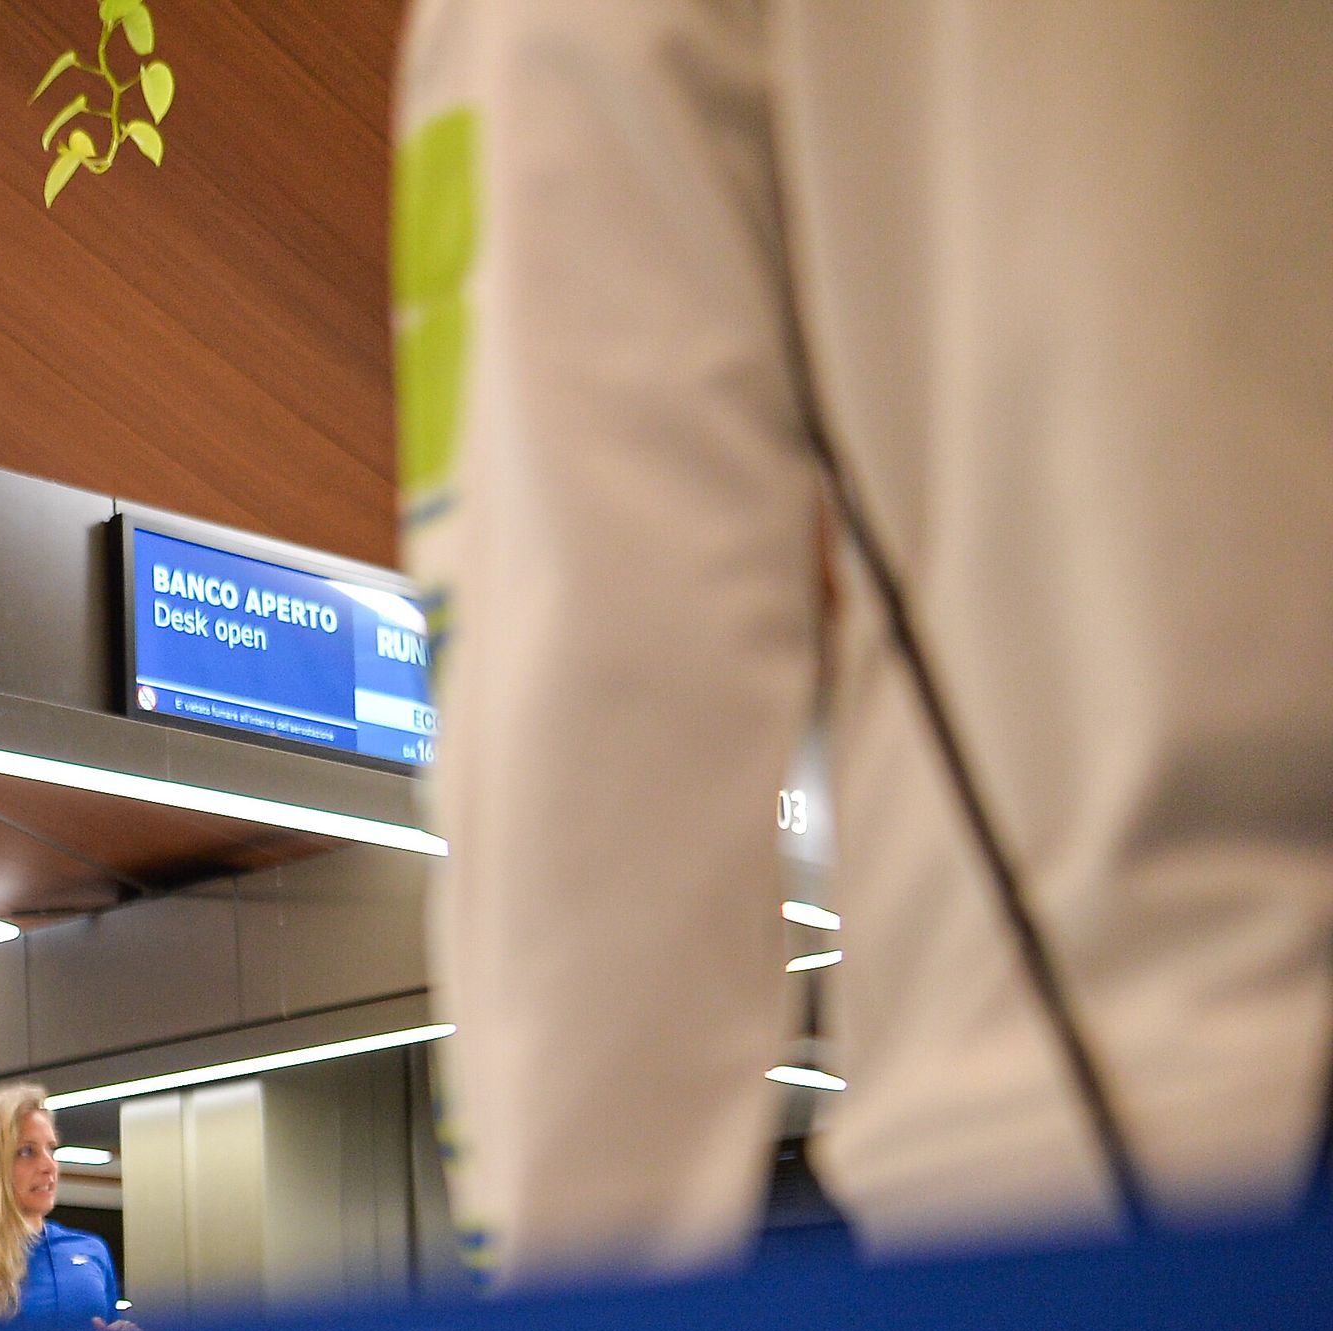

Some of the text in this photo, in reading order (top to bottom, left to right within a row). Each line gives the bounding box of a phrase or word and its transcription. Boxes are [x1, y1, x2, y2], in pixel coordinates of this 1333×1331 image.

[152, 563, 339, 633] BANCO APERTO
[154, 599, 267, 651] Desk open
[376, 625, 430, 667] RUN
[417, 739, 434, 762] 16
[777, 790, 808, 835] 03
